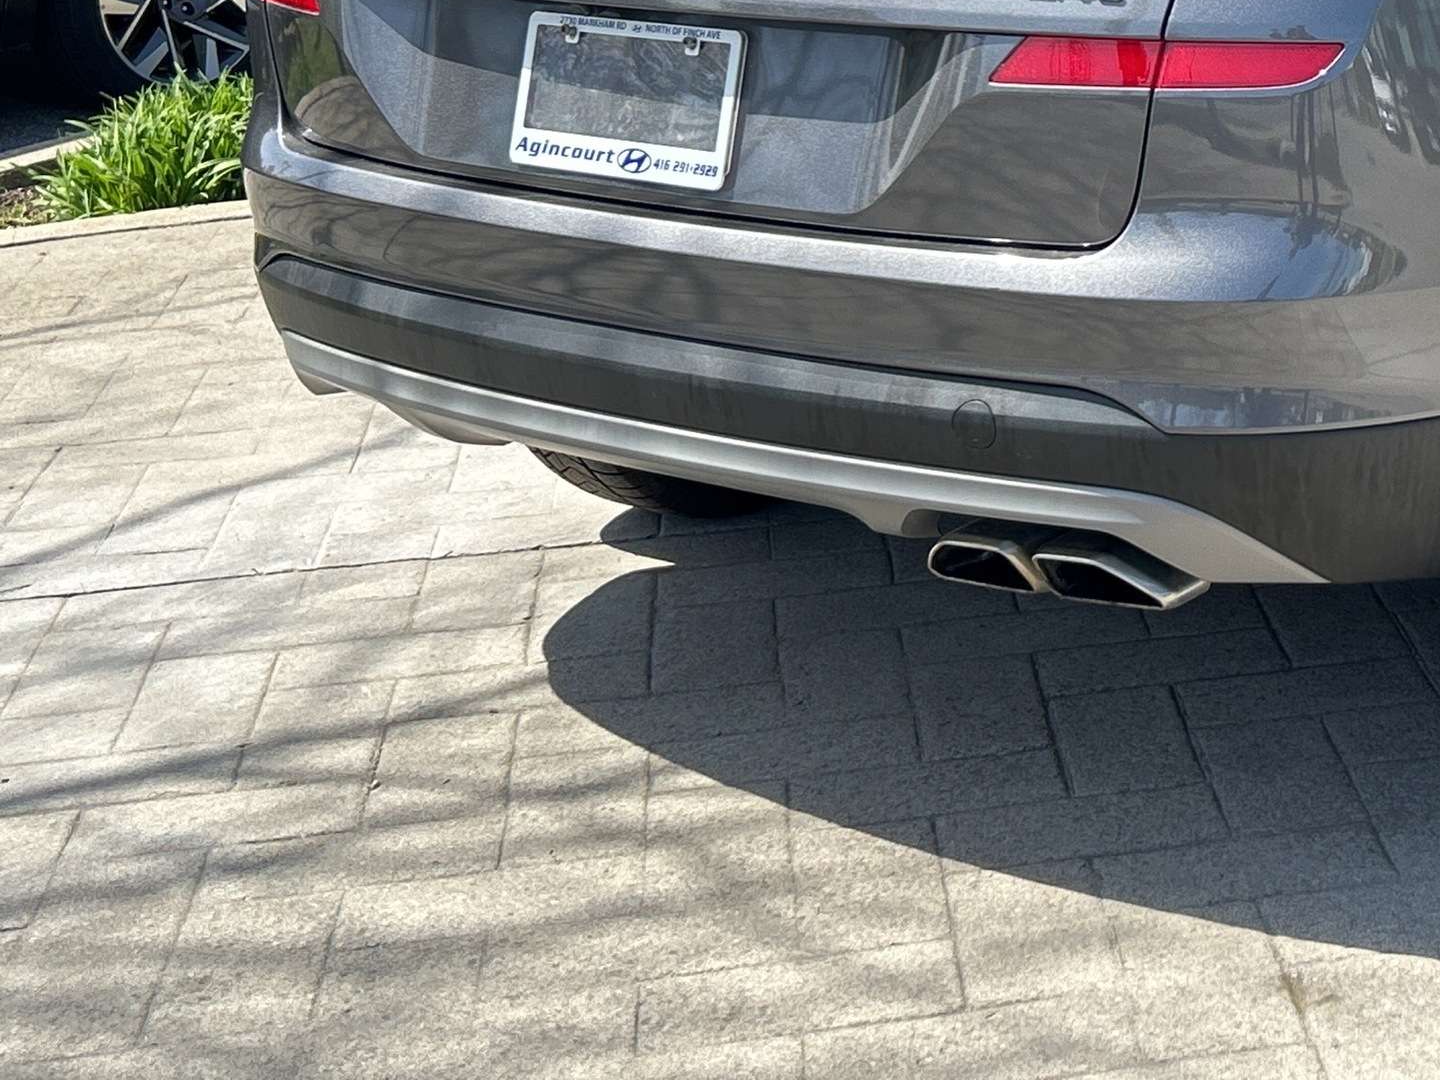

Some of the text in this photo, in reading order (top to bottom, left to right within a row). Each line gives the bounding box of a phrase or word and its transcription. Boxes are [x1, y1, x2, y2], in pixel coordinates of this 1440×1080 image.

[616, 21, 627, 30] RD
[645, 23, 671, 34] NORTH
[672, 27, 682, 35] OF
[683, 28, 705, 37] FINCH
[707, 30, 721, 39] AVE
[515, 136, 616, 164] Agincourt
[653, 159, 670, 170] 416
